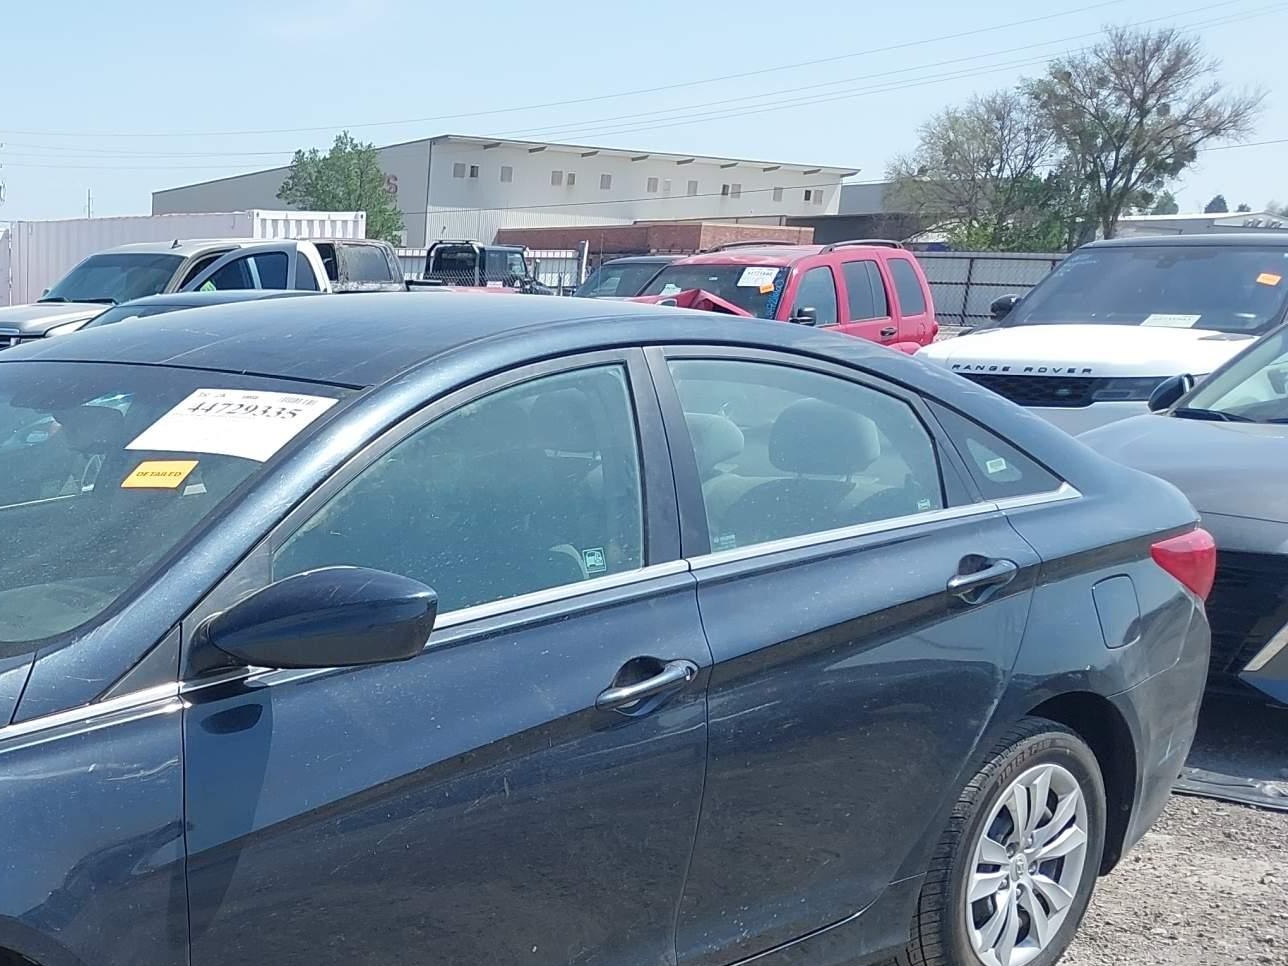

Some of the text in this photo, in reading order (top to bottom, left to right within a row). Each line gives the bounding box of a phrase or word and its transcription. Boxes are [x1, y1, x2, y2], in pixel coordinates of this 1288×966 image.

[951, 364, 1093, 374] RANGE ROVER
[187, 401, 303, 418] 44729335
